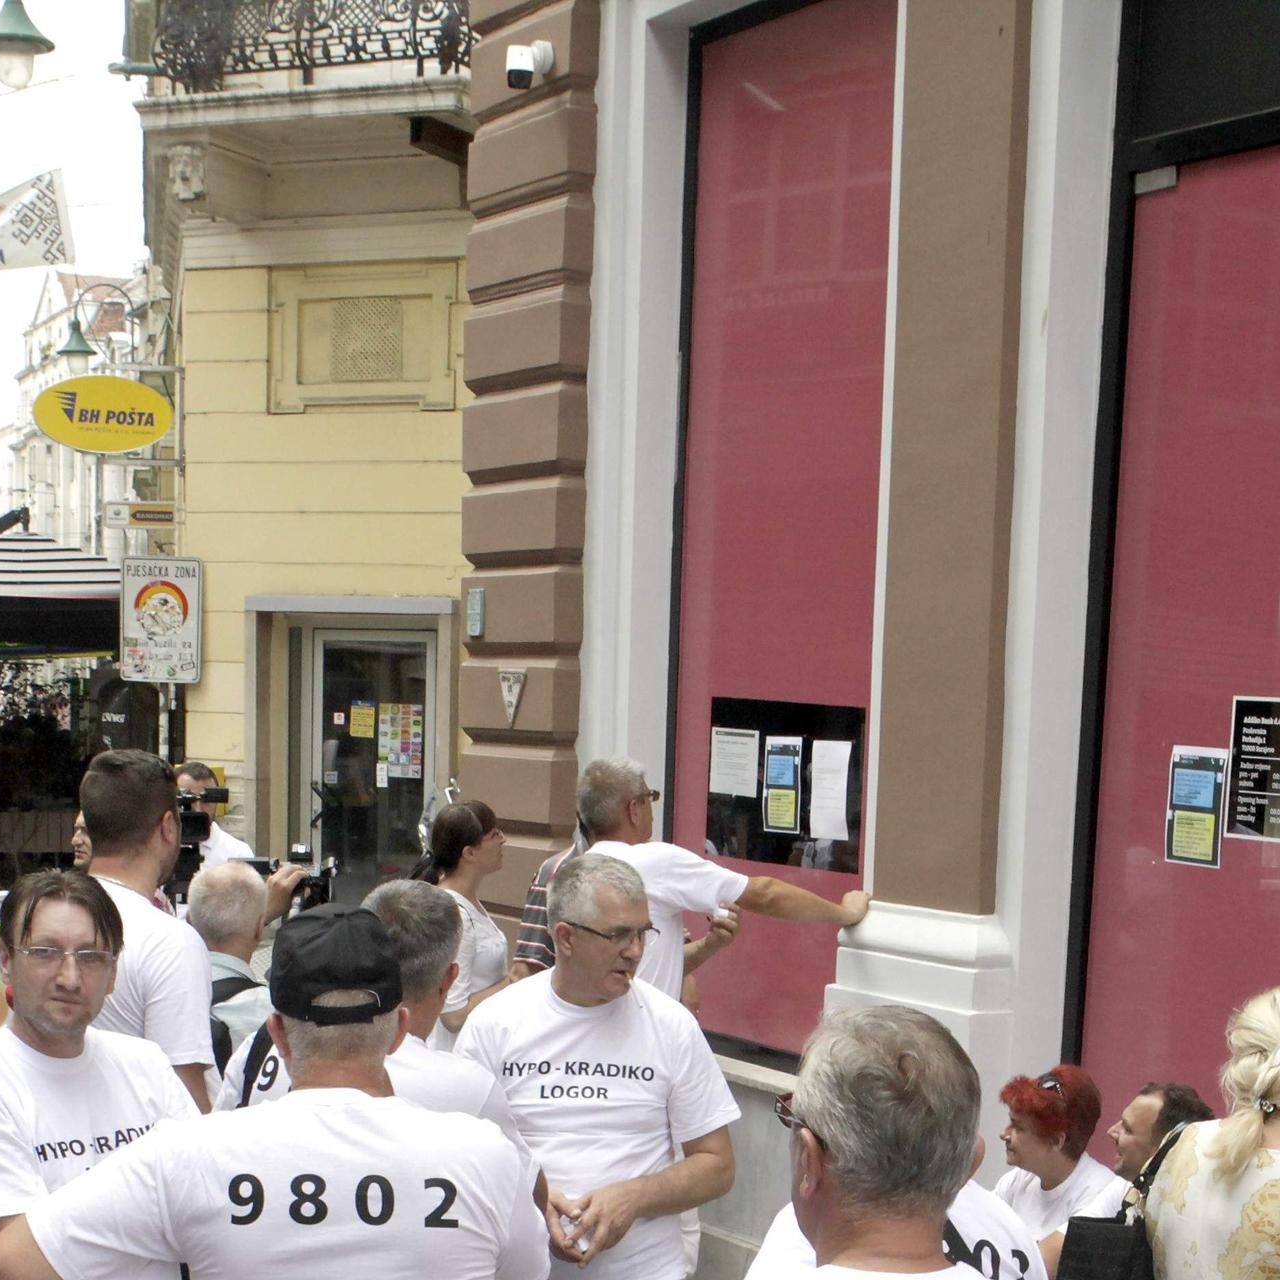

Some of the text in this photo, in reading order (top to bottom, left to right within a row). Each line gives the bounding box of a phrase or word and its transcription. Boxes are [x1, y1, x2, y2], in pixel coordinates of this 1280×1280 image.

[78, 407, 155, 427] BH POŠTA
[174, 567, 197, 578] ZONA
[501, 1060, 552, 1077] HYPO
[563, 1060, 655, 1083] KRADIKO
[539, 1084, 609, 1100] LOGOR
[34, 1138, 86, 1162] HYPO
[227, 1173, 460, 1229] 9802
